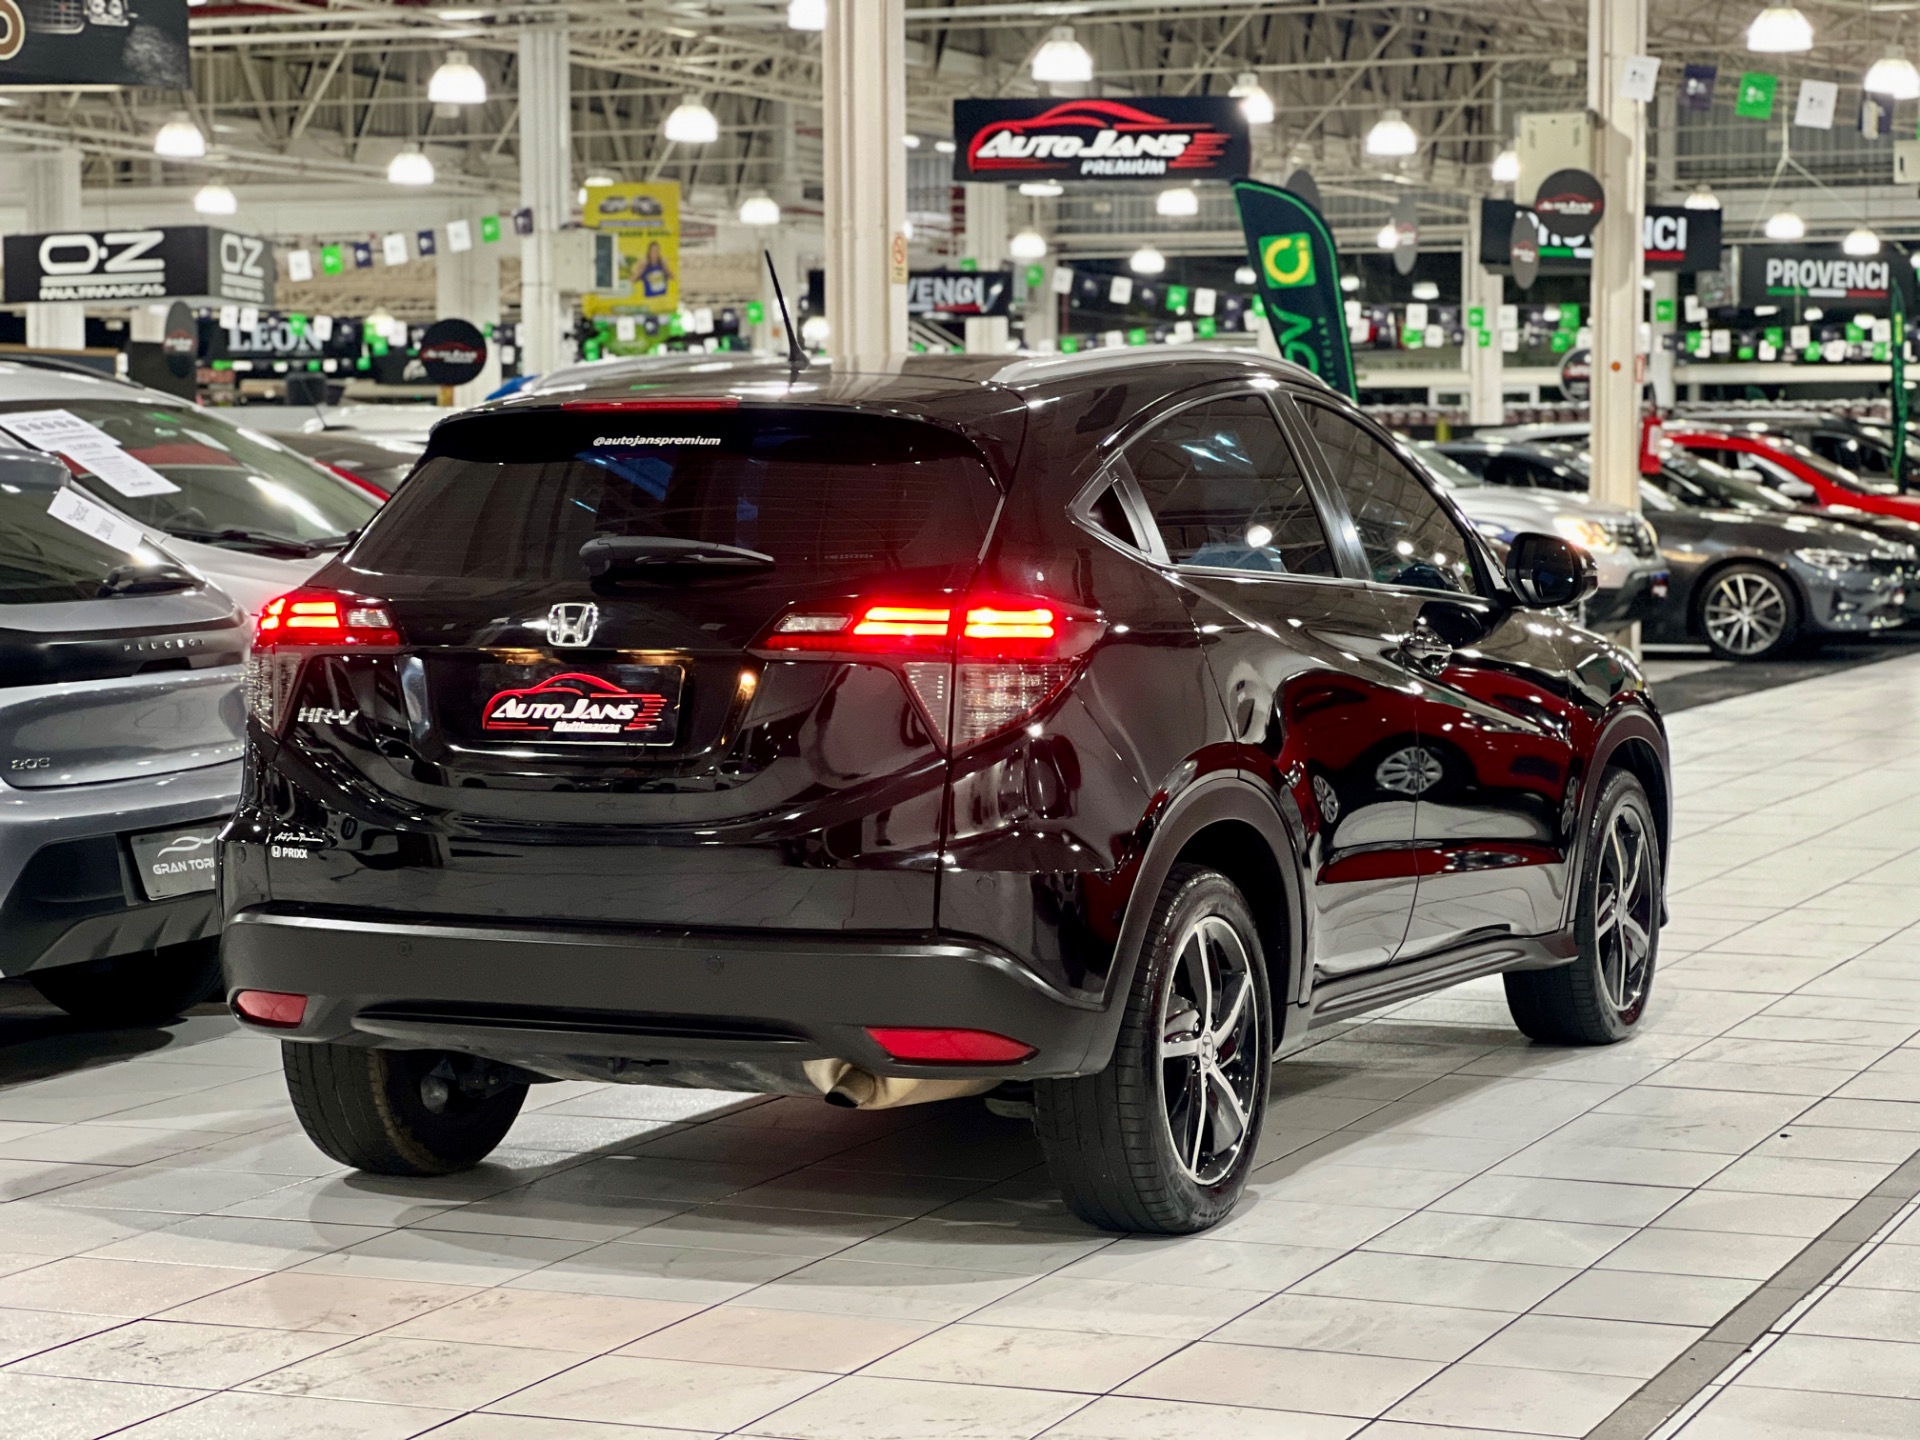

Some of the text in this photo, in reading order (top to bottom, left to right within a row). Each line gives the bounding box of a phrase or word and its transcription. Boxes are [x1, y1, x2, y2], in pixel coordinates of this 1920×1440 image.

[1080, 159, 1166, 175] PREMIUM
[1766, 258, 1890, 290] PROVENCI
[592, 434, 722, 447] @autojanspremium
[297, 706, 359, 726] HR-V
[282, 847, 308, 859] PRIXX
[152, 859, 188, 875] GRAN
